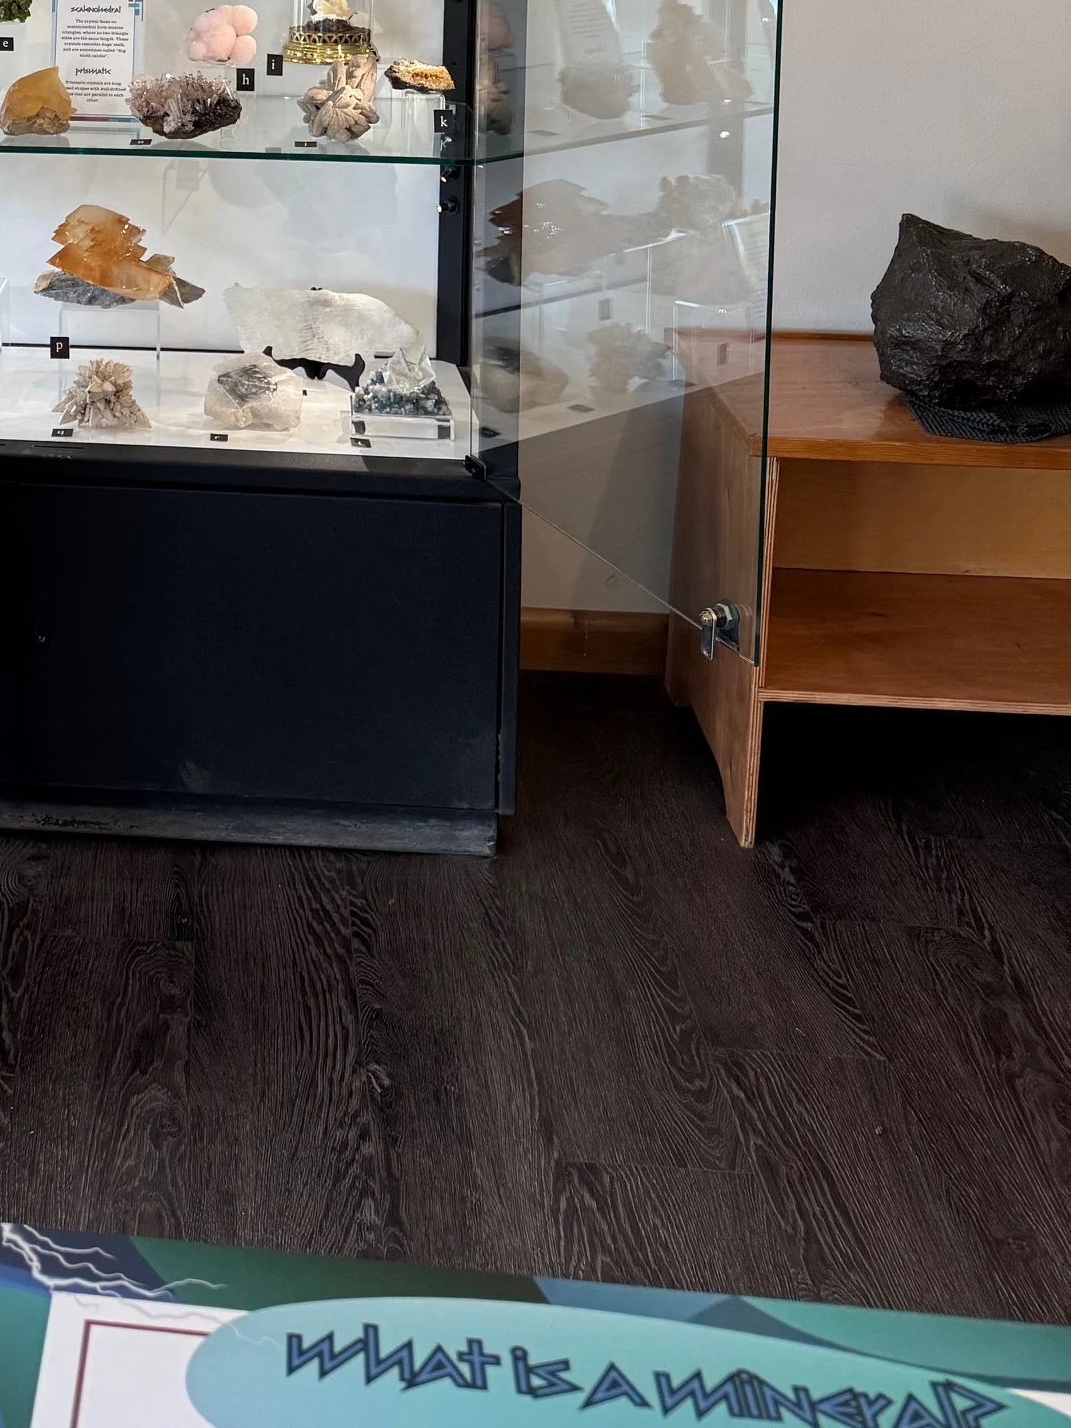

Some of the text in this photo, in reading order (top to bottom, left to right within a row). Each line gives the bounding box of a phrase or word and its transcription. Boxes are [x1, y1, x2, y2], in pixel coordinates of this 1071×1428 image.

[2, 39, 8, 47] e
[271, 60, 275, 70] i
[242, 74, 250, 85] h
[440, 115, 448, 127] k
[56, 342, 63, 352] p
